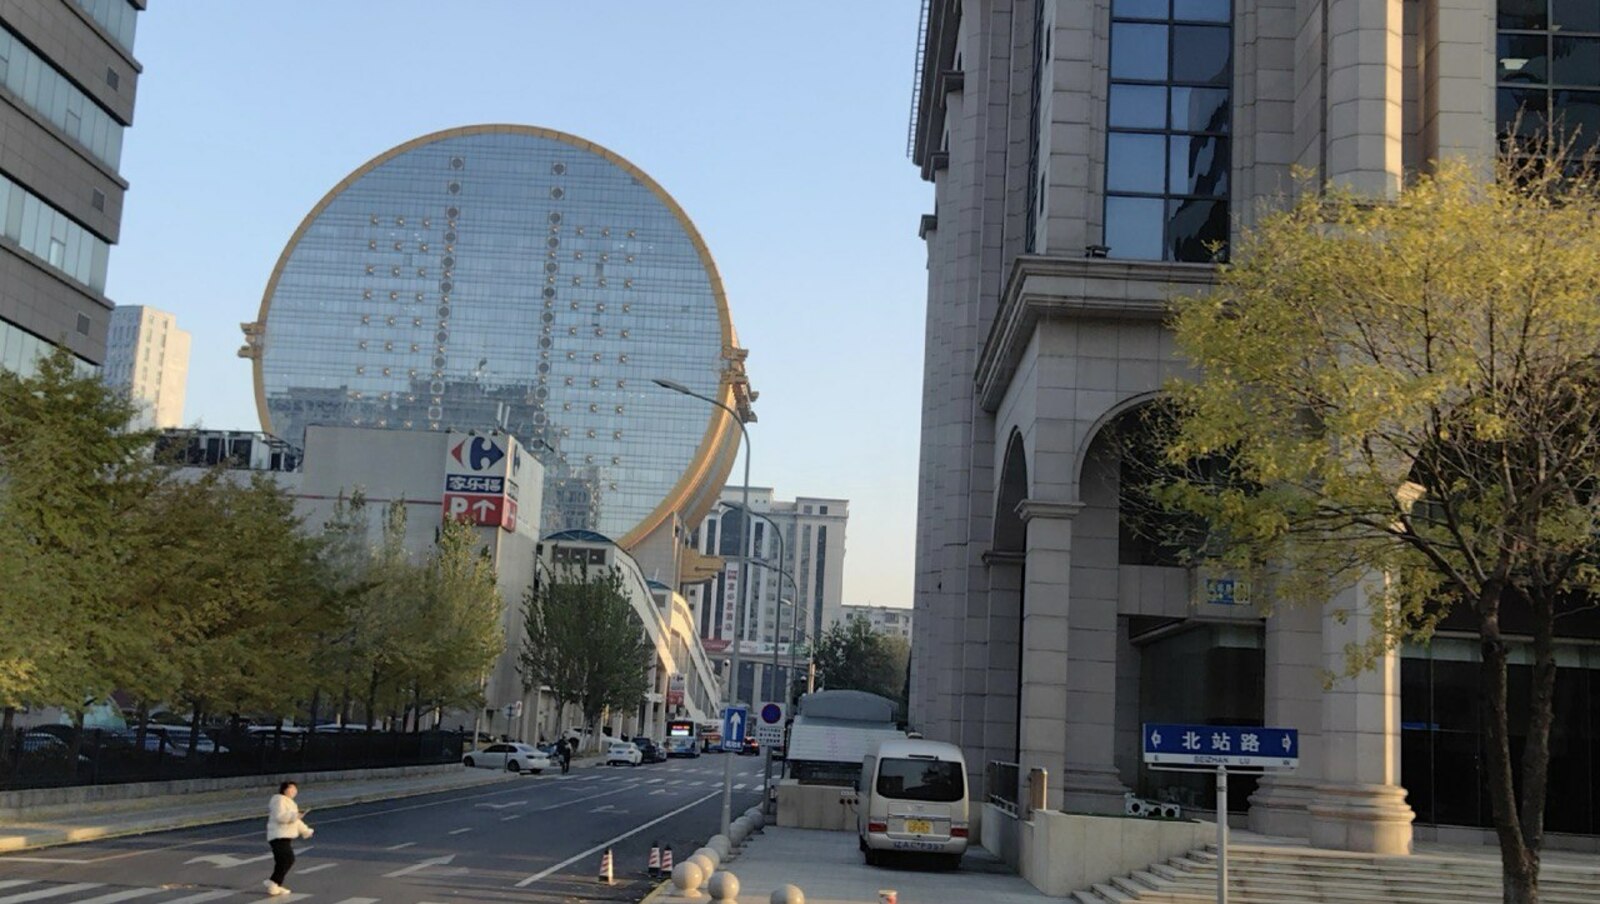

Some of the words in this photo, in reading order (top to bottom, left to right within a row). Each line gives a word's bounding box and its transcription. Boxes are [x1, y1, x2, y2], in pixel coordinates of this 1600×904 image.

[448, 476, 501, 491] 家乐福
[450, 497, 468, 521] P
[1182, 731, 1260, 752] 北站路
[1193, 756, 1229, 764] BEIZHAN
[1239, 757, 1250, 765] LU
